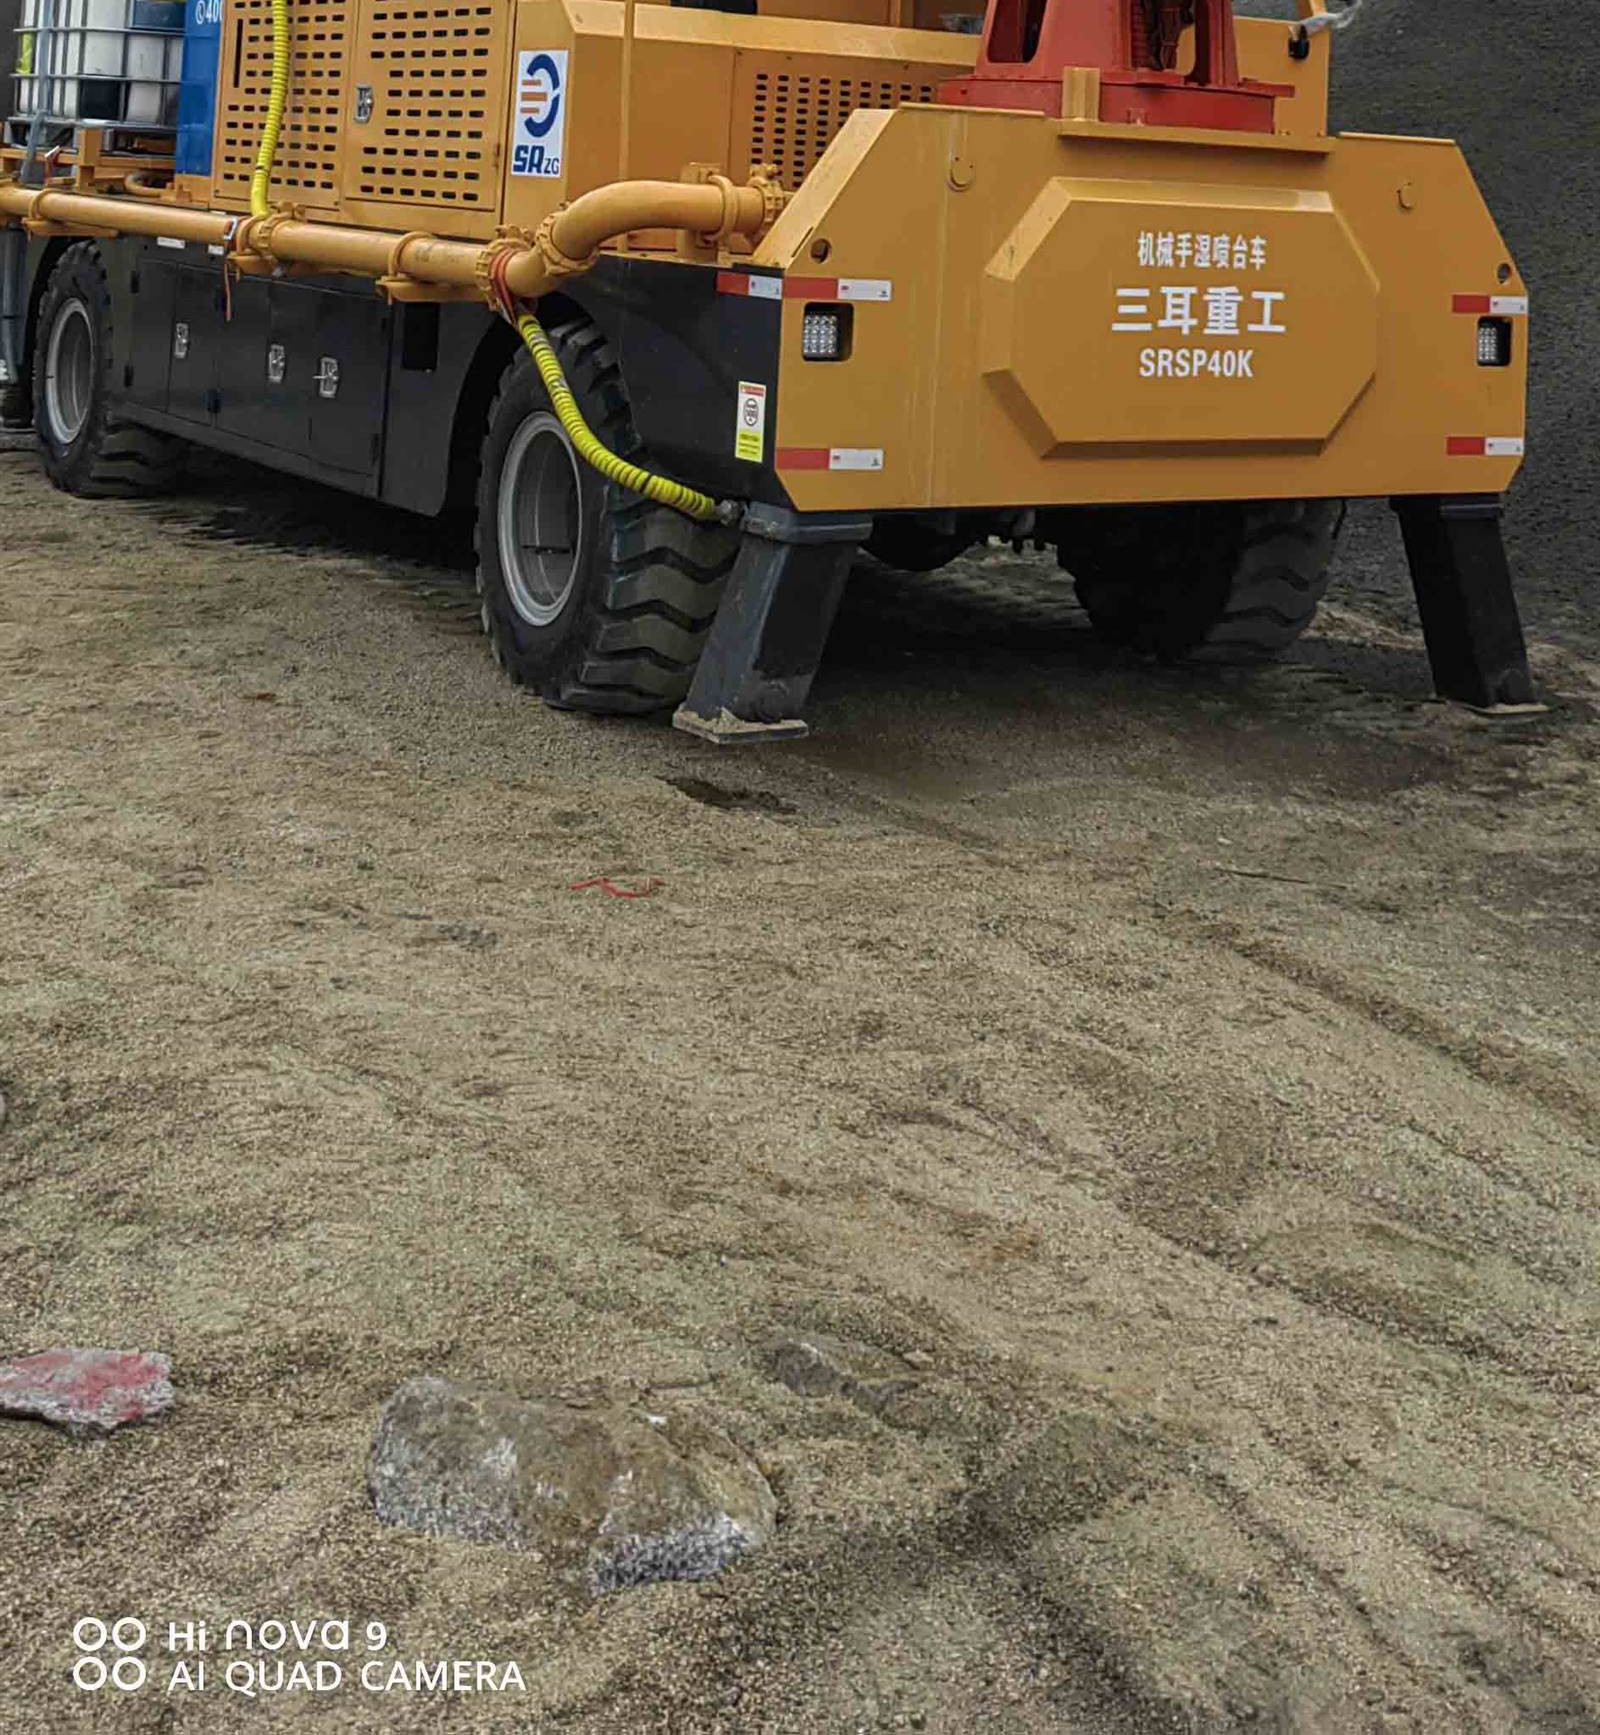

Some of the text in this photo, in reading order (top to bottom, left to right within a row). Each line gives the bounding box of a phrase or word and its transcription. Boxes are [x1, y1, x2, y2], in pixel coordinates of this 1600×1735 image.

[1137, 230, 1268, 271] 机械手湿喷台车
[1111, 285, 1287, 336] 三耳重工
[1139, 347, 1254, 378] SRSP40K
